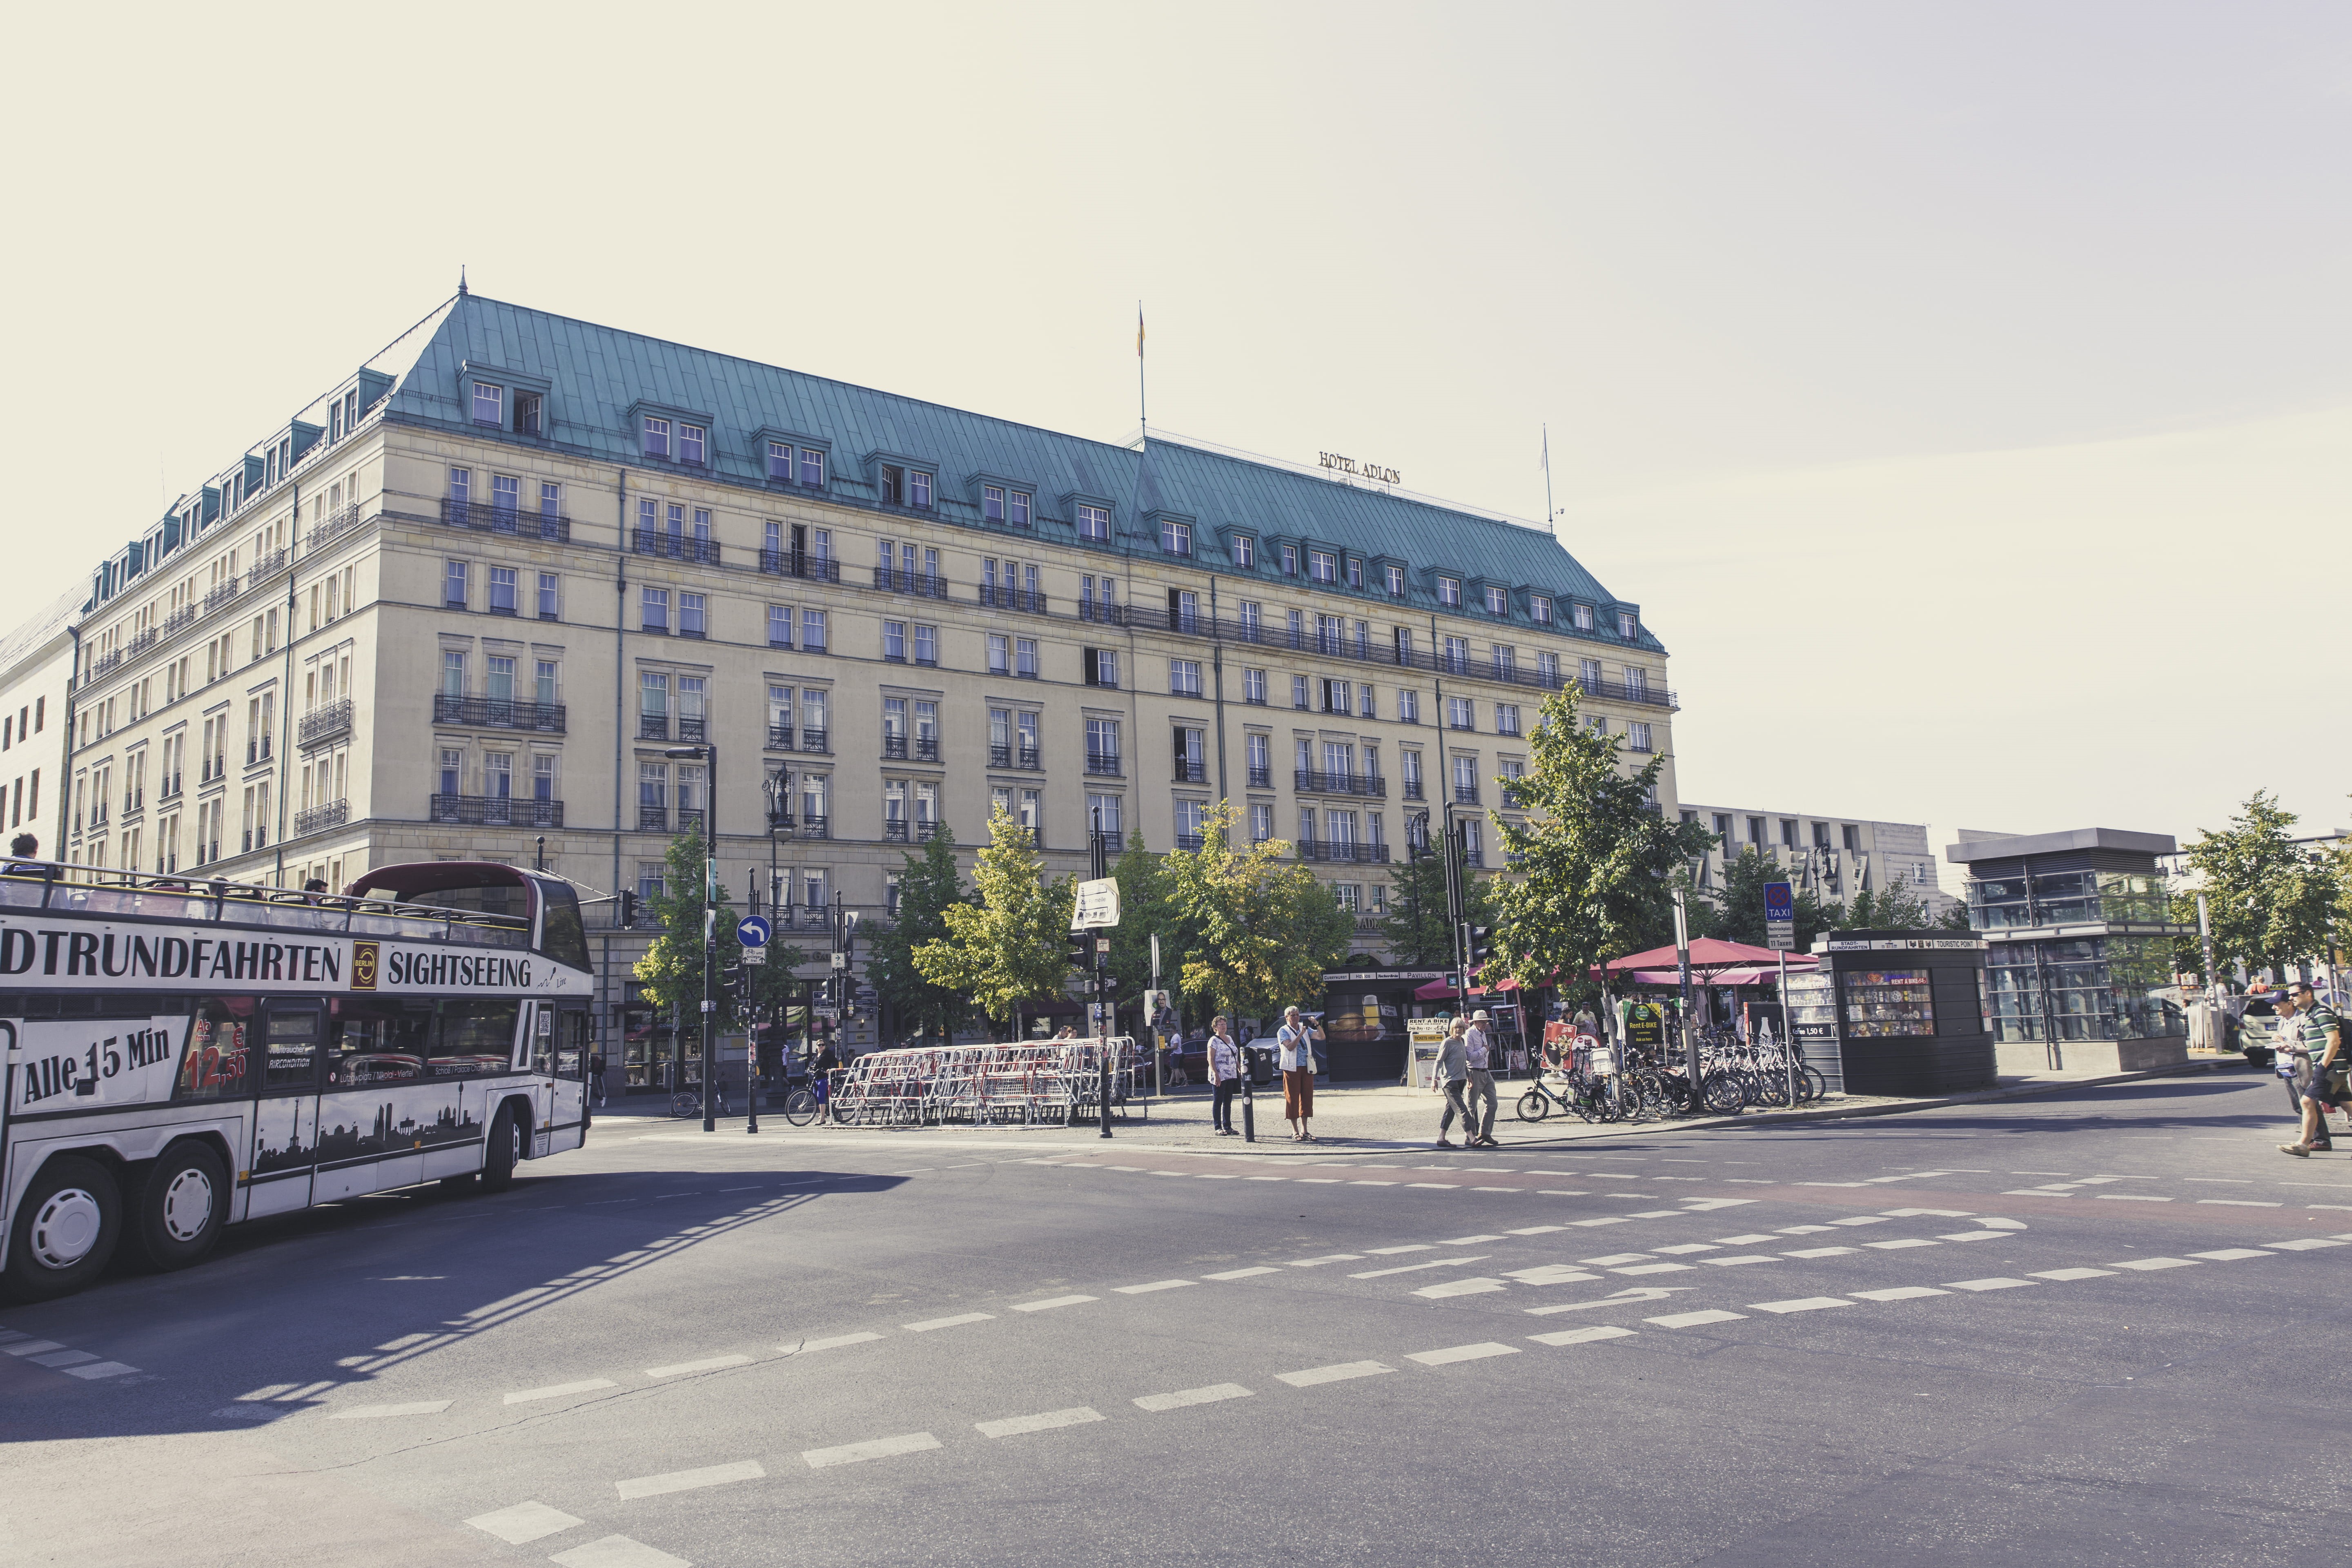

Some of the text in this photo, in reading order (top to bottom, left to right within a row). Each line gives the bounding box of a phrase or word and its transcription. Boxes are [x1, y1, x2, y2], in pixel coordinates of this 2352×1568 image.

[1318, 451, 1400, 484] HOTEL ADLON
[1768, 909, 1790, 917] TAXI
[388, 951, 531, 987] SIGHTSEEING
[557, 978, 566, 988] Live
[196, 1019, 211, 1032] Ab
[196, 1034, 210, 1042] from
[270, 1045, 305, 1054] Nichtraucher
[24, 1027, 170, 1104] Alle 15 Min
[269, 1058, 310, 1069] AIRCONDITION
[376, 1071, 394, 1079] Nikolai
[397, 1069, 413, 1078] Viertel
[435, 1067, 450, 1075] Schloß
[454, 1065, 470, 1074] Palace
